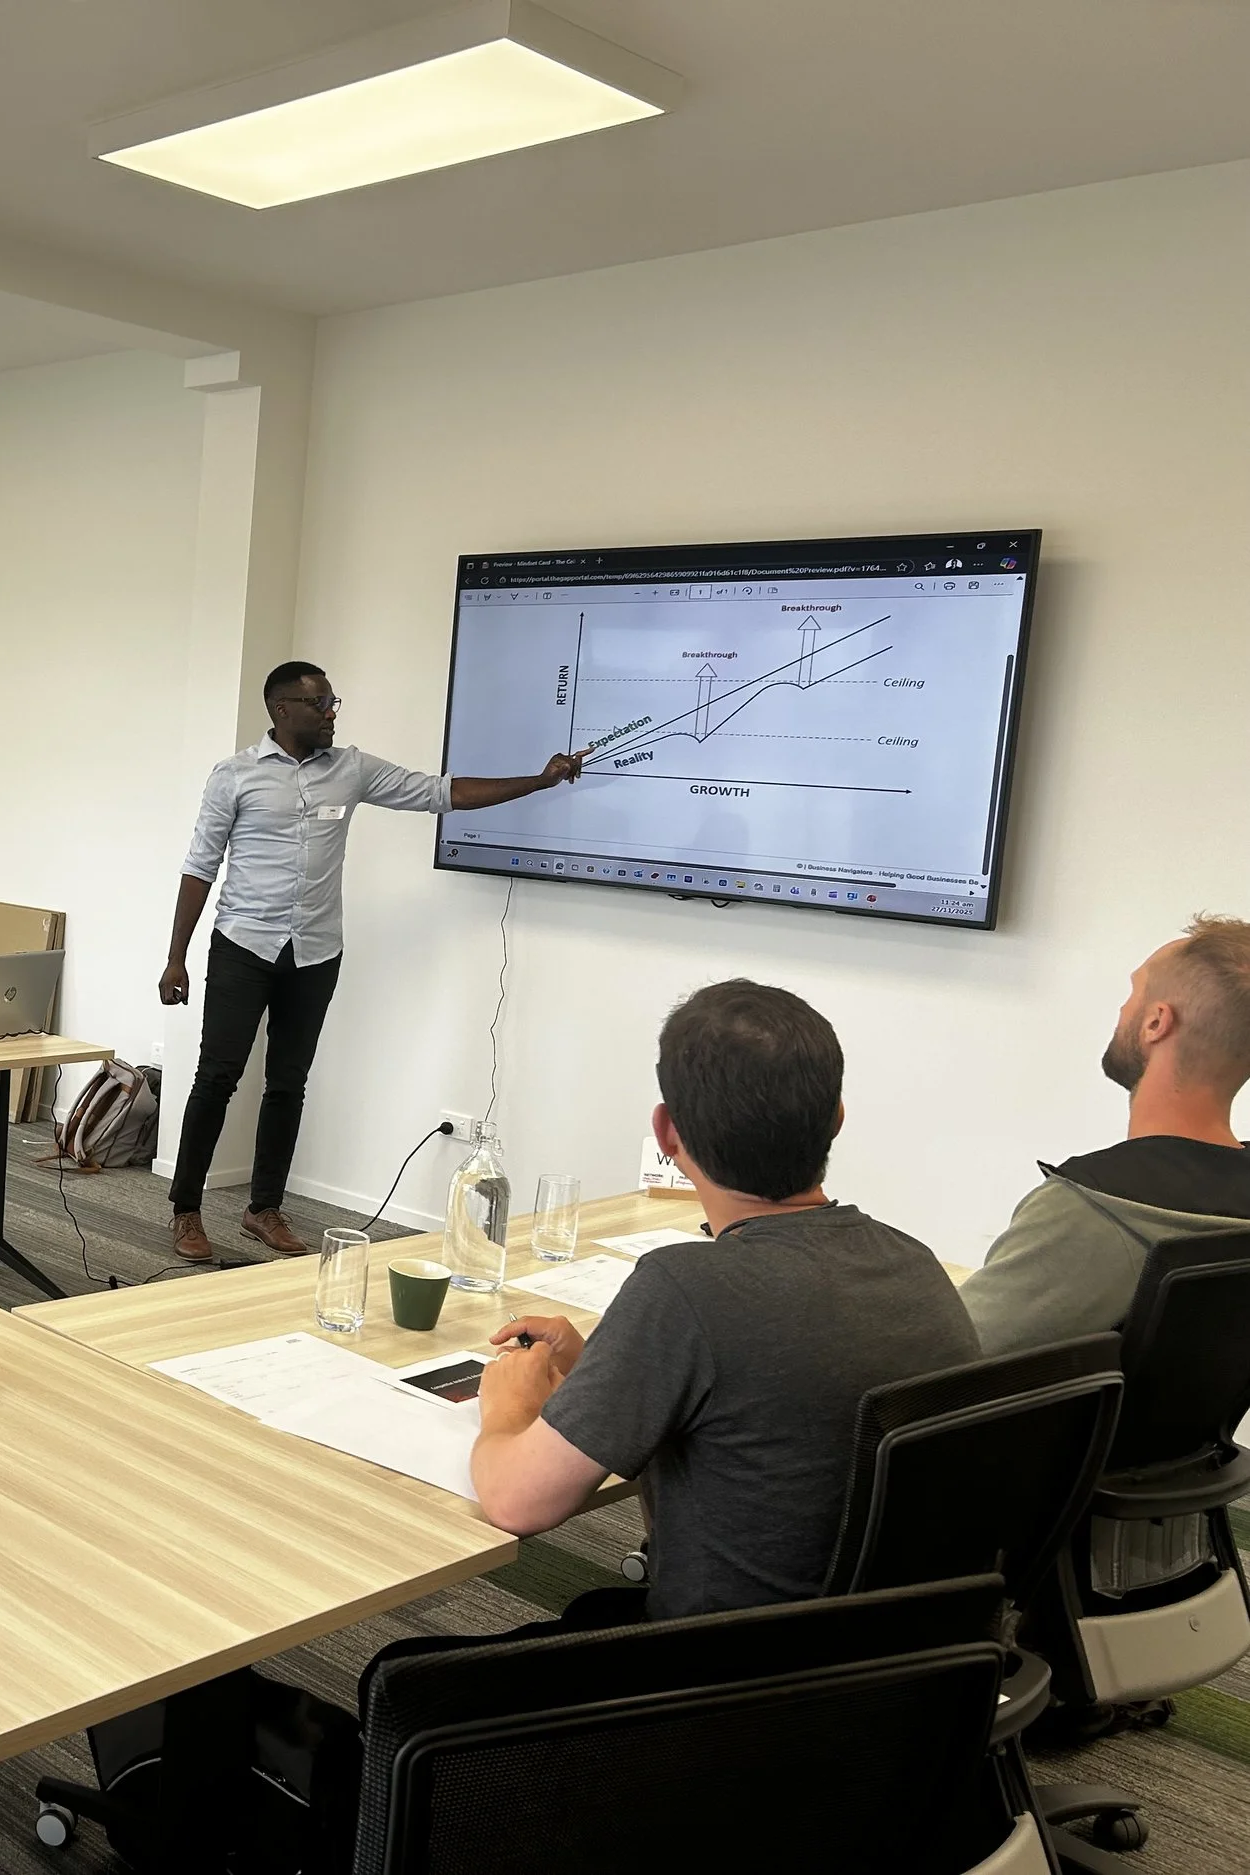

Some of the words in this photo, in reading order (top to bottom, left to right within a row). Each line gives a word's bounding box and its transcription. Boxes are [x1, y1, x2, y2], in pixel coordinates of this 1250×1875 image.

[781, 604, 842, 613] Breakthrough
[682, 651, 738, 660] Breakthrough
[556, 665, 569, 706] RETURN
[883, 677, 925, 690] Ceiling
[588, 715, 653, 750] Expectation
[877, 735, 919, 749] Ceiling
[613, 750, 654, 769] Reality
[689, 784, 751, 798] GROWTH
[807, 864, 837, 872] Business
[838, 867, 873, 876] Navigators
[878, 870, 905, 879] Helping
[906, 873, 925, 881] Good
[926, 875, 967, 885] Businesses
[931, 906, 973, 915] 27/11/2025
